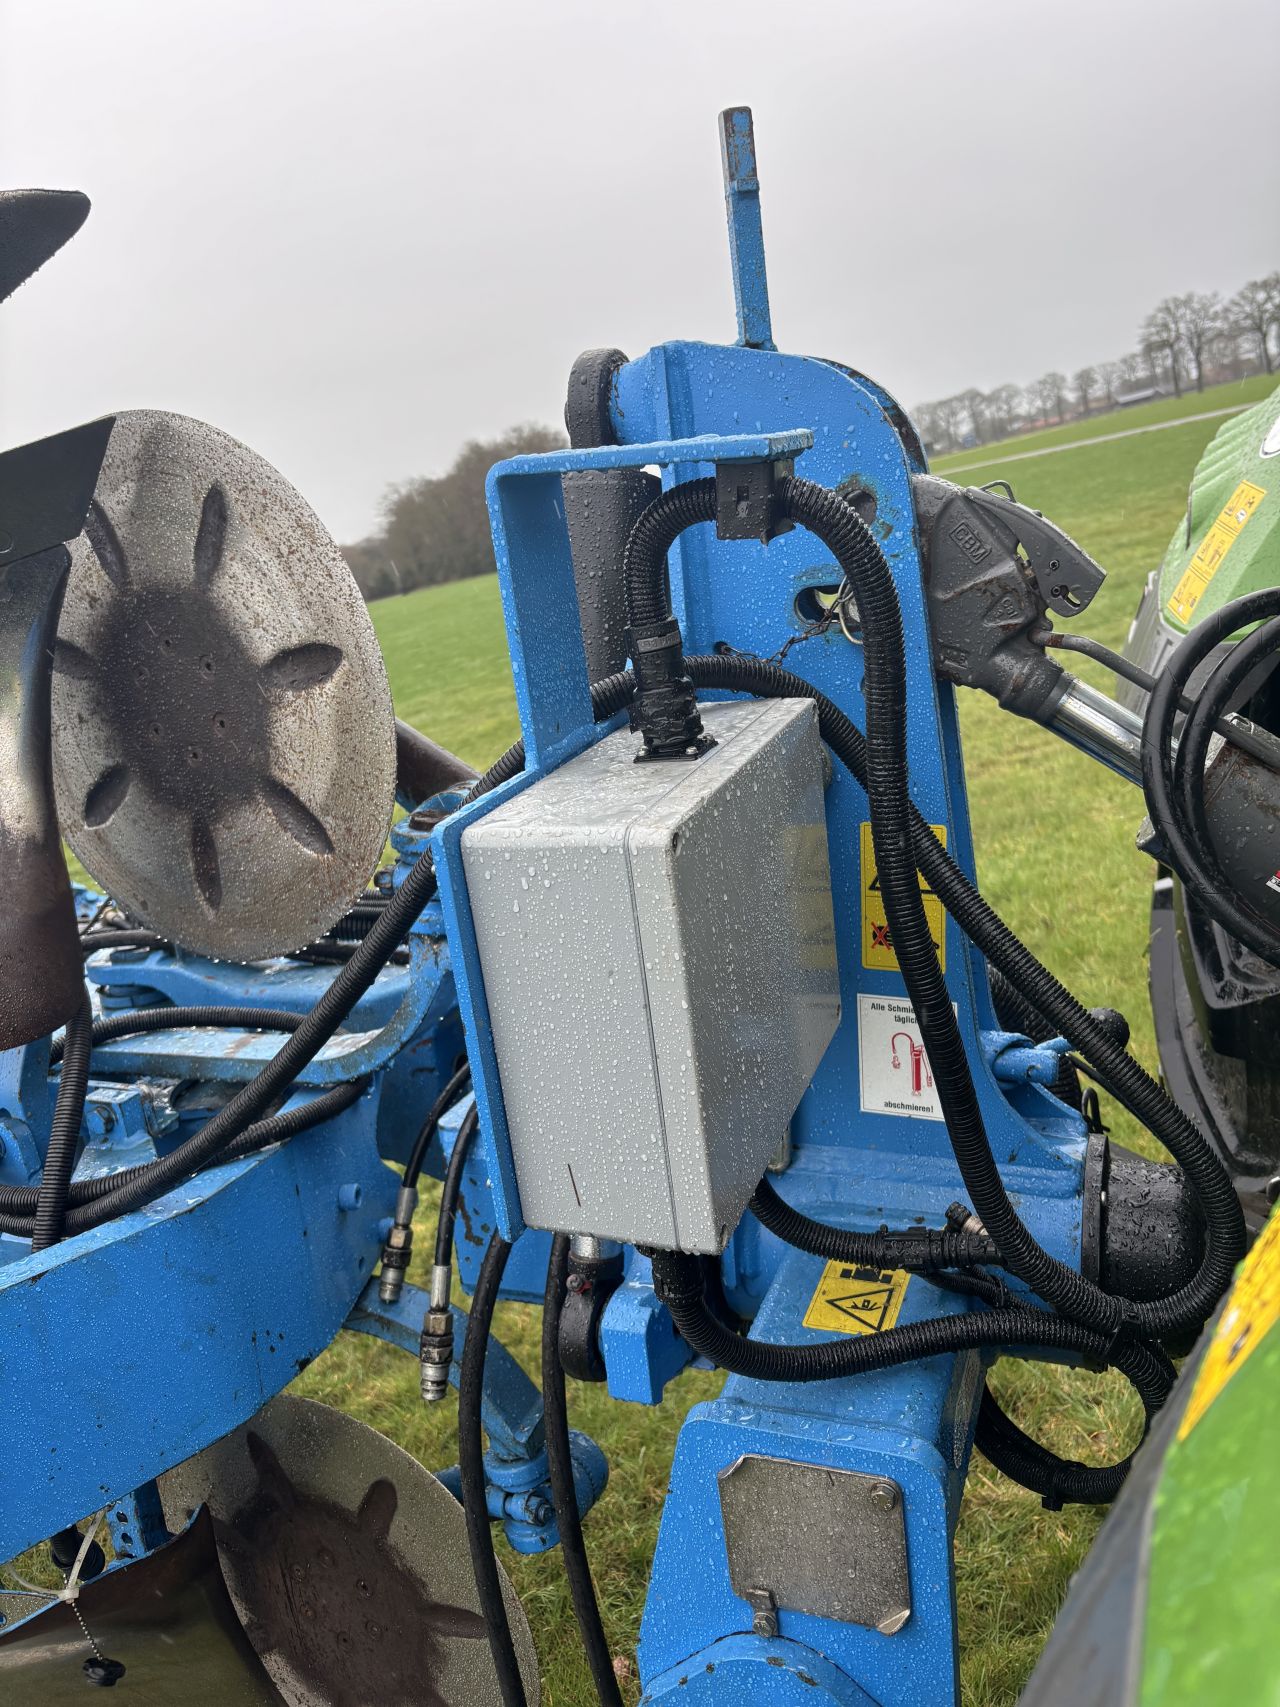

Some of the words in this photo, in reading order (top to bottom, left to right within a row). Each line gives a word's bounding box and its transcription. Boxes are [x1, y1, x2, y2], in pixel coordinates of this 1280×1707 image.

[871, 1002, 885, 1011] Alle
[887, 1003, 915, 1014] Schmie
[884, 1100, 934, 1113] abschmieren!
